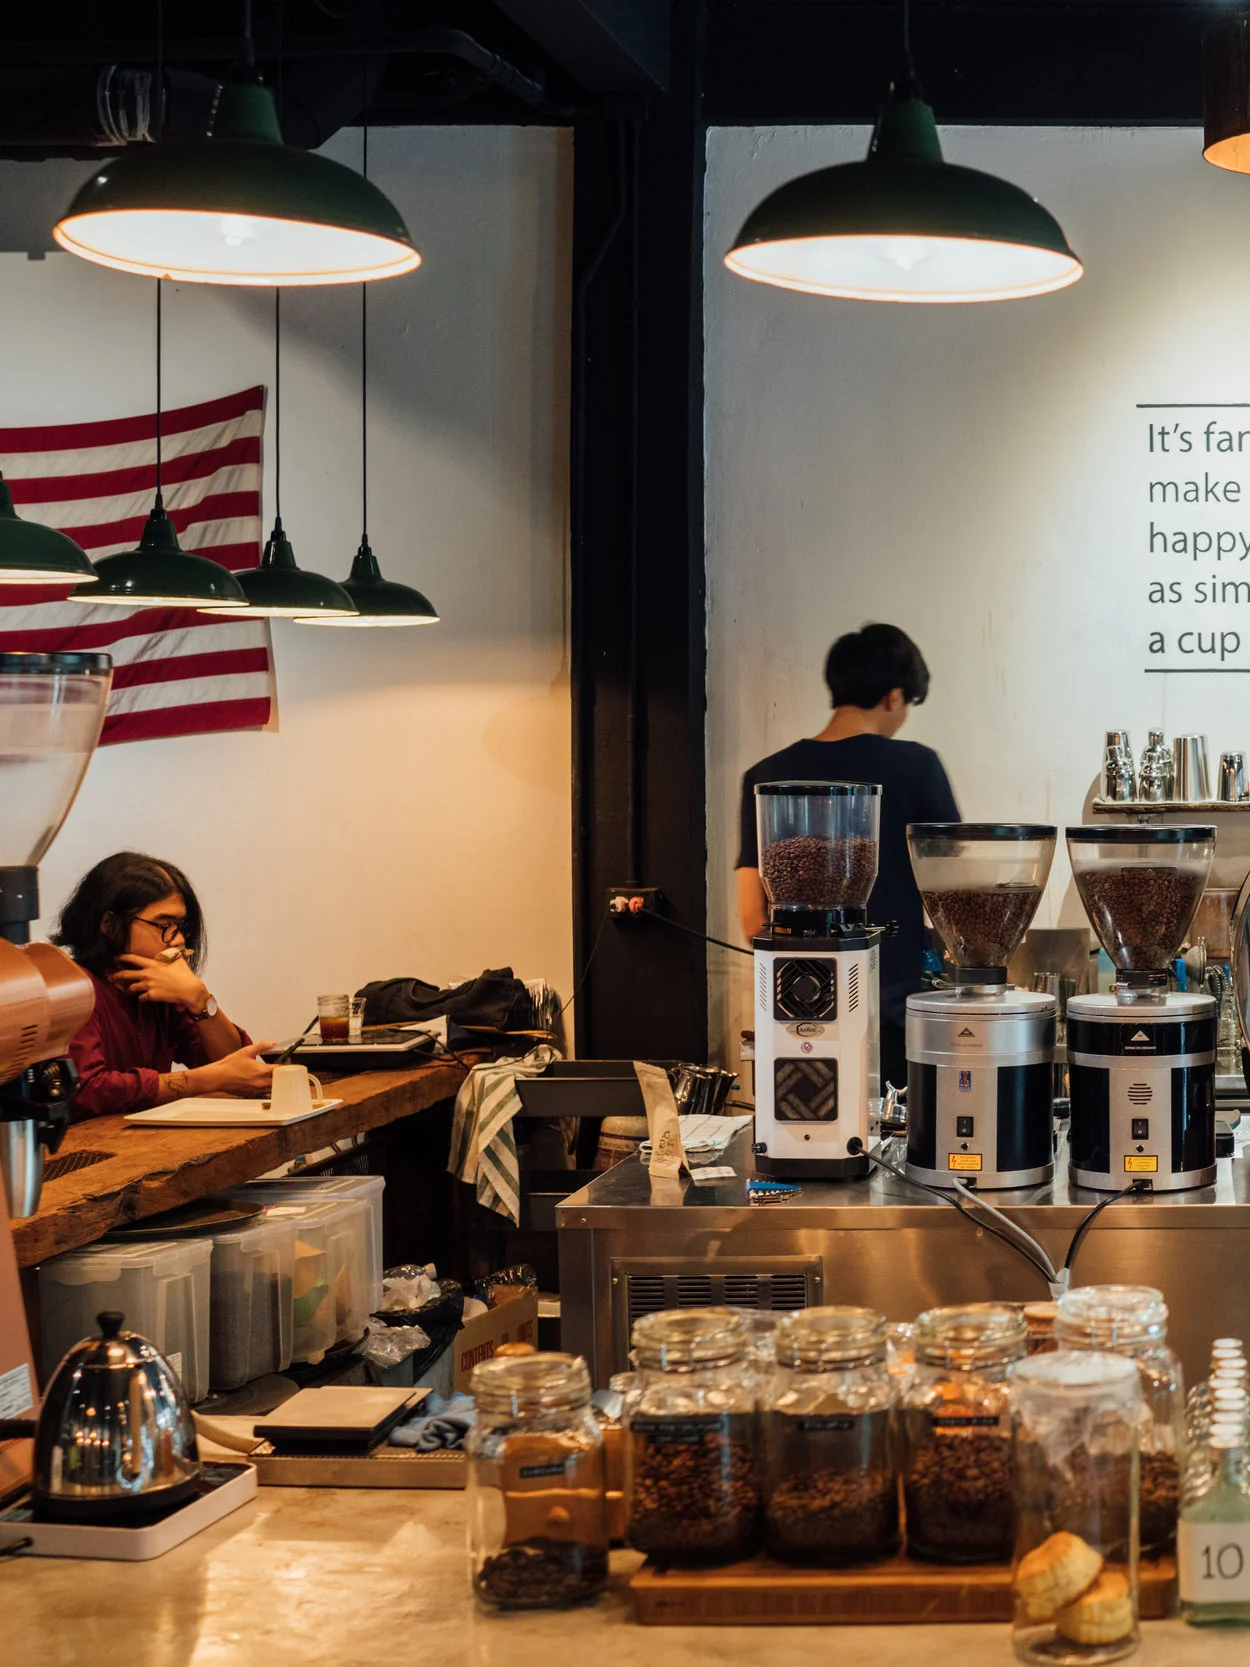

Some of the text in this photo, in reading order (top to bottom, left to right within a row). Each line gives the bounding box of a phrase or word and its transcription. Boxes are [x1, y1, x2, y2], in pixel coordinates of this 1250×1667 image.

[1148, 423, 1193, 453] It’s
[1148, 471, 1241, 503] make
[1148, 580, 1182, 604] as
[1149, 631, 1165, 654] a
[1177, 631, 1240, 661] cup
[1201, 1542, 1244, 1580] 10
